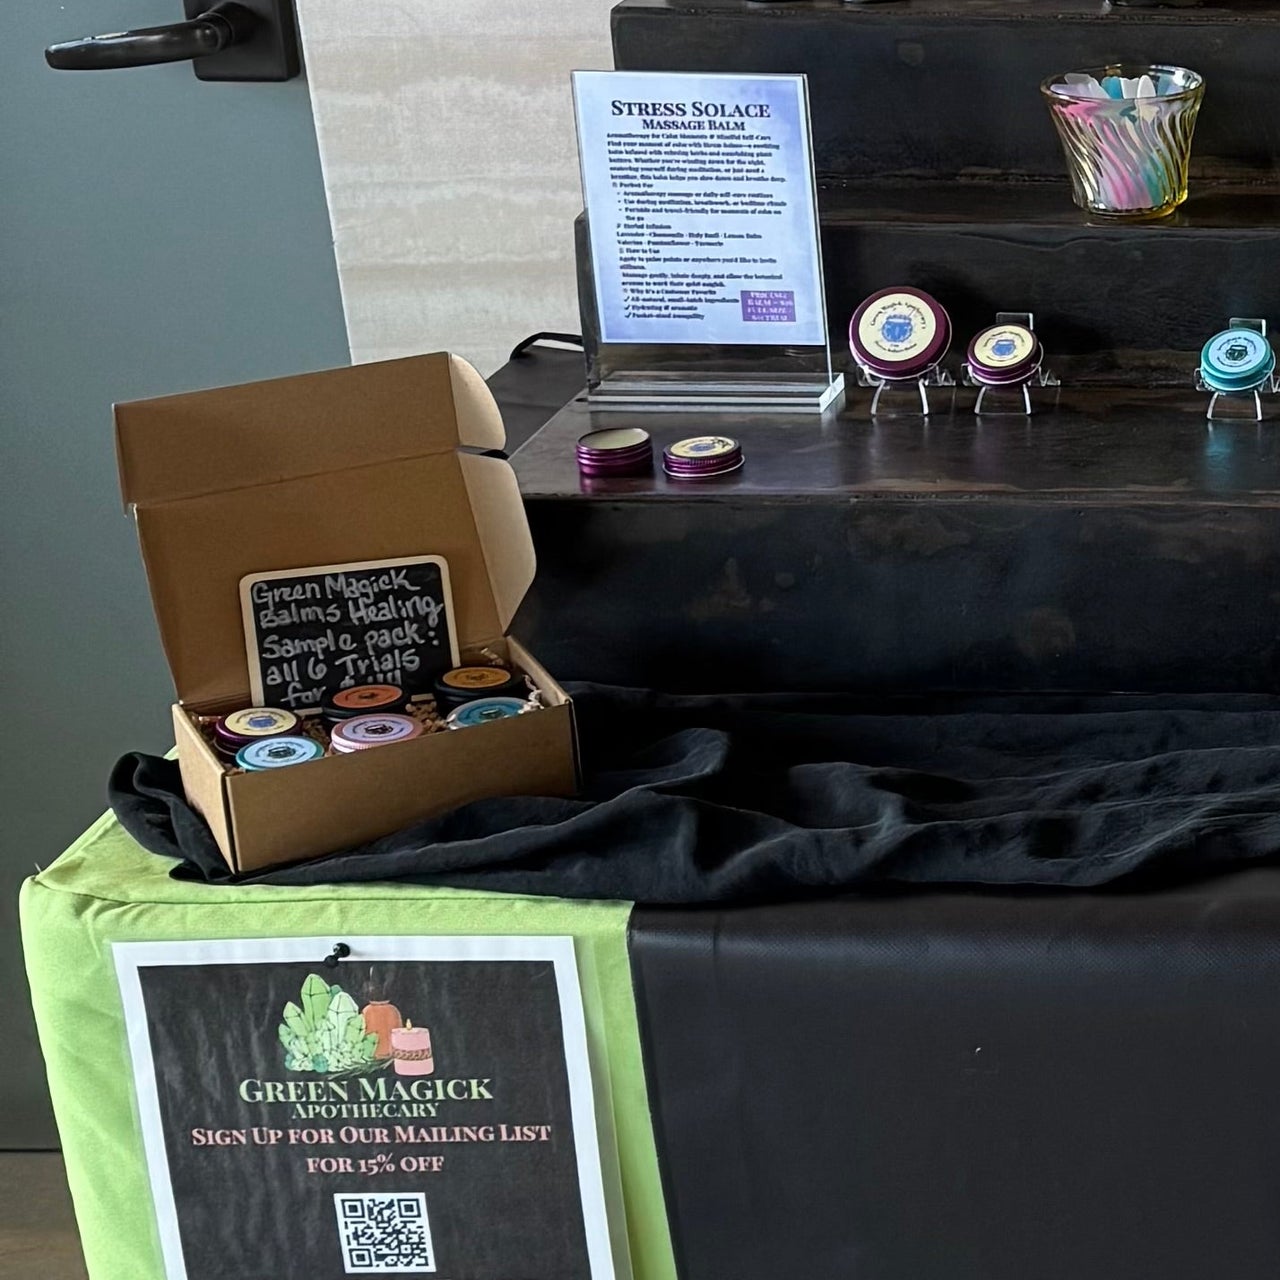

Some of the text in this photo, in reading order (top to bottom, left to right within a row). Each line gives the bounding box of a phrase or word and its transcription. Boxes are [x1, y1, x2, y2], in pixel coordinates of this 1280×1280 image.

[611, 100, 771, 118] STRESS SOLACE
[642, 119, 746, 131] MASSAGE BALM
[252, 569, 421, 605] Green Magick
[349, 590, 444, 627] Healing
[262, 620, 440, 660] Sample pack:
[266, 648, 421, 686] all 6 Trials
[281, 684, 326, 708] for
[238, 1076, 493, 1104] GREEN MAGICK
[291, 1102, 440, 1119] APOTHECARY
[191, 1123, 551, 1147] SIGN UP FOR OUR MAILING LIST
[306, 1153, 445, 1175] FOR 15% OFF
